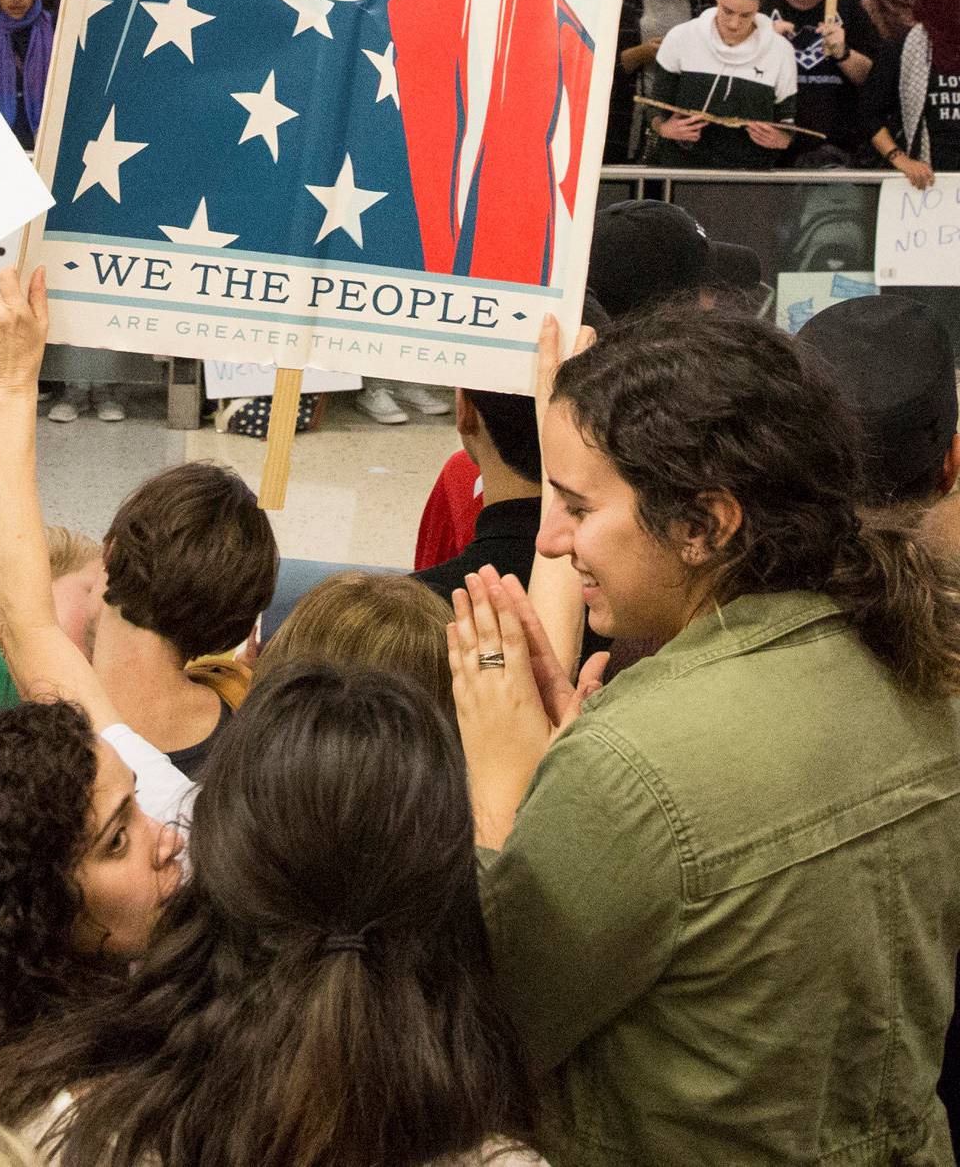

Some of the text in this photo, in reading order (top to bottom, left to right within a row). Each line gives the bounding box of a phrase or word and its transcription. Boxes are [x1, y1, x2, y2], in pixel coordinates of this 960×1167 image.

[938, 74, 960, 87] LO
[901, 188, 943, 221] NO
[895, 229, 928, 252] NO
[89, 251, 500, 330] WE THE PEOPLE
[106, 313, 468, 366] ARE GREATER THAN FEAR
